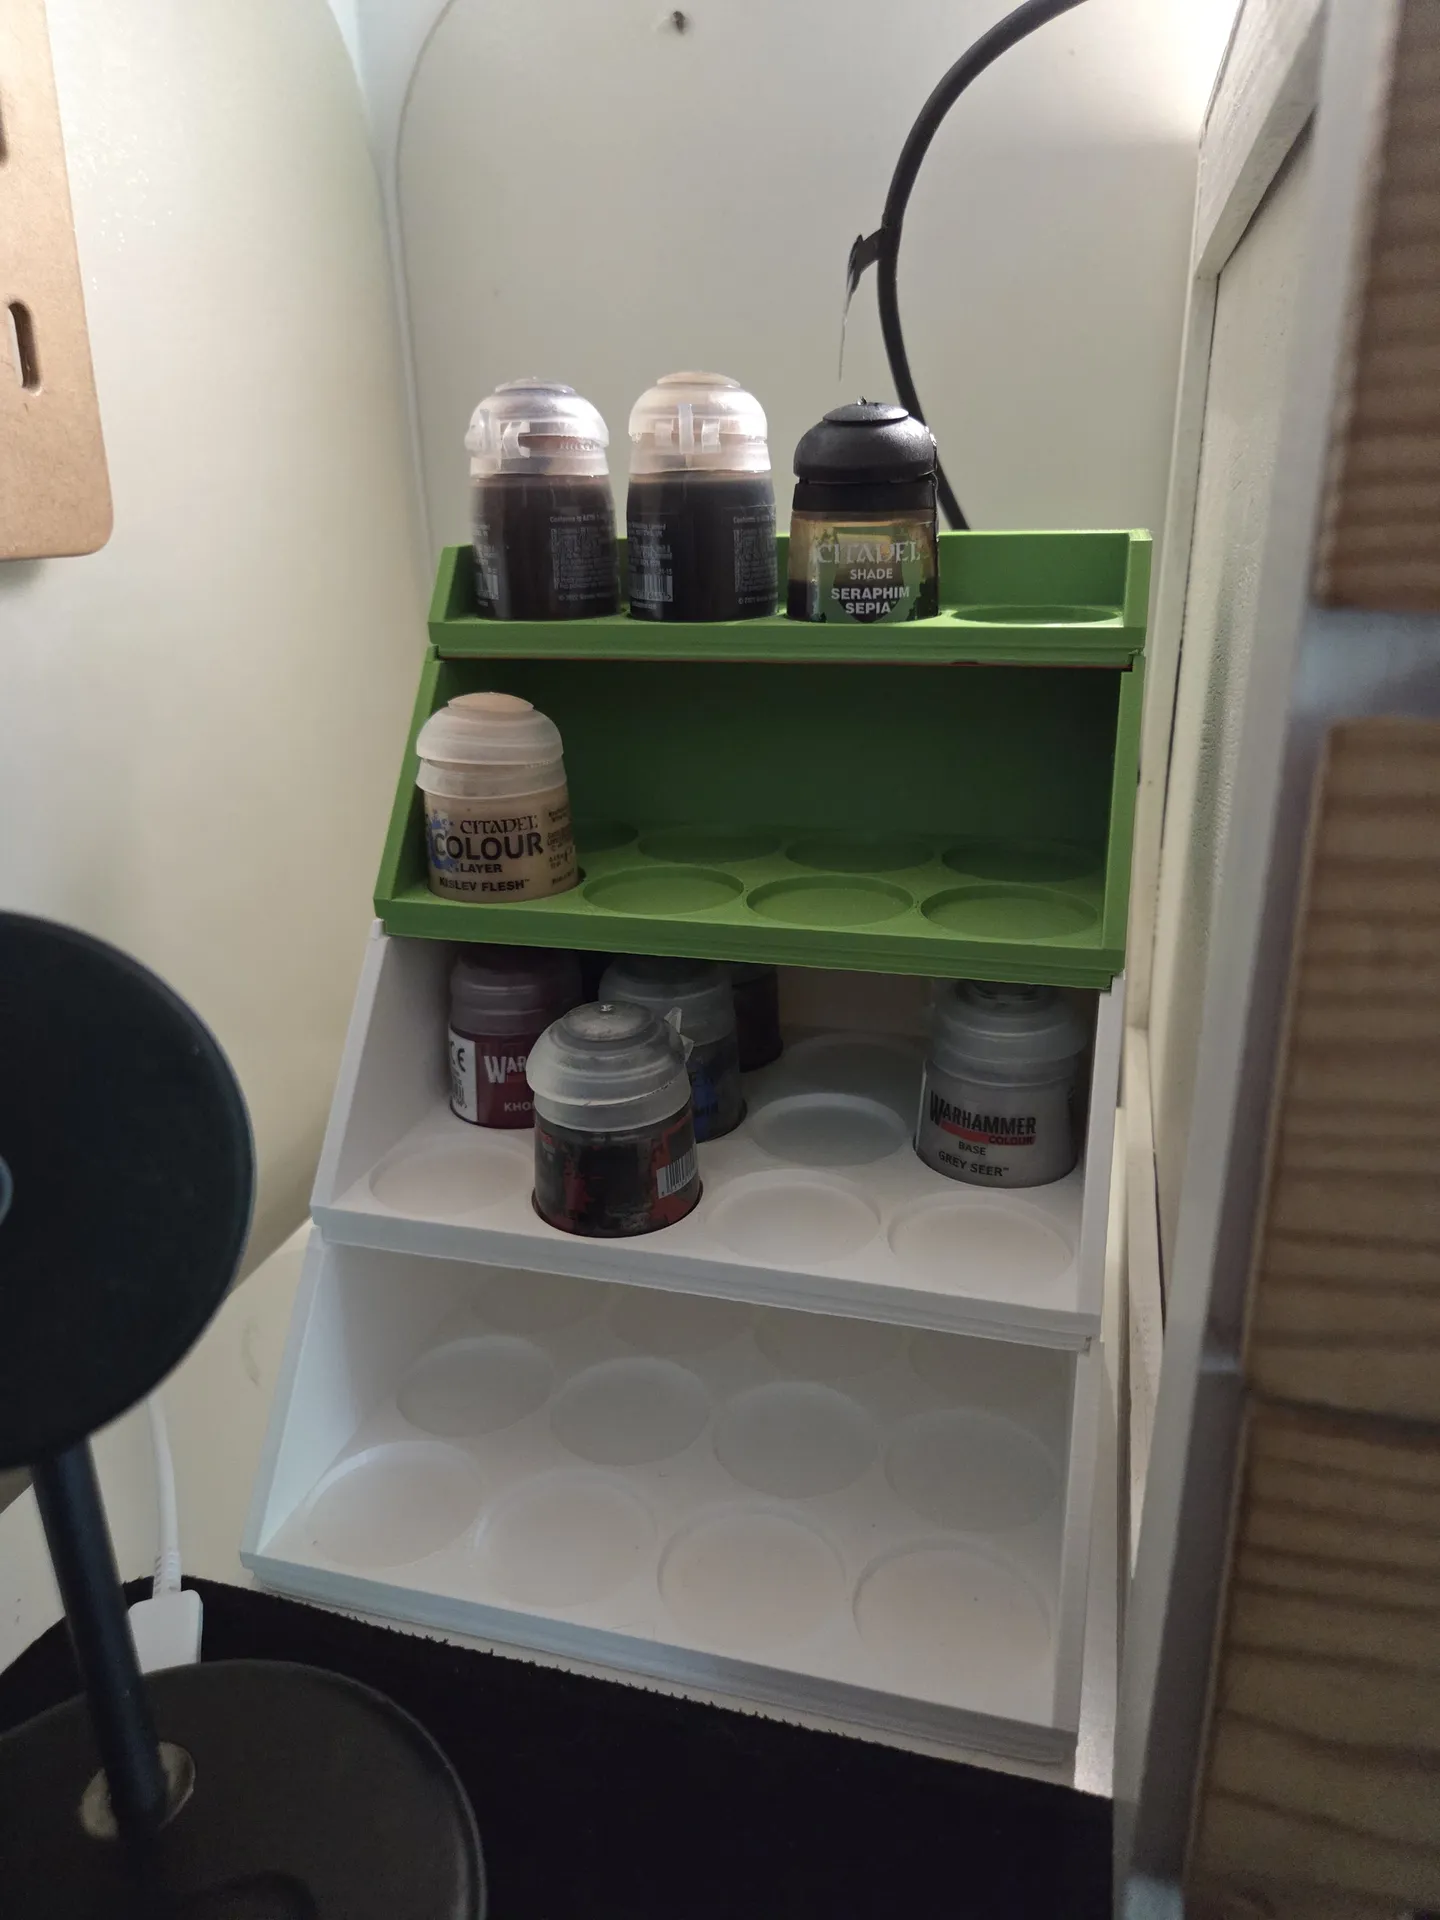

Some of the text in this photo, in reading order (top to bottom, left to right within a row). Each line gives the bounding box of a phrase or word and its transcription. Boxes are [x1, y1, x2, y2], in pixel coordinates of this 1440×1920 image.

[816, 540, 921, 564] CITADEL
[850, 567, 894, 580] SHADE
[831, 586, 910, 600] SERAPHIM
[459, 815, 538, 834] CITADEL
[433, 832, 544, 861] COLOUR
[460, 863, 503, 874] LAYER
[439, 876, 477, 892] KISLEV
[504, 1101, 535, 1112] KHO
[929, 1090, 1037, 1135] WARHAMMER
[988, 1134, 1035, 1145] COLOUR
[958, 1141, 987, 1156] BASE
[938, 1150, 968, 1169] GREY
